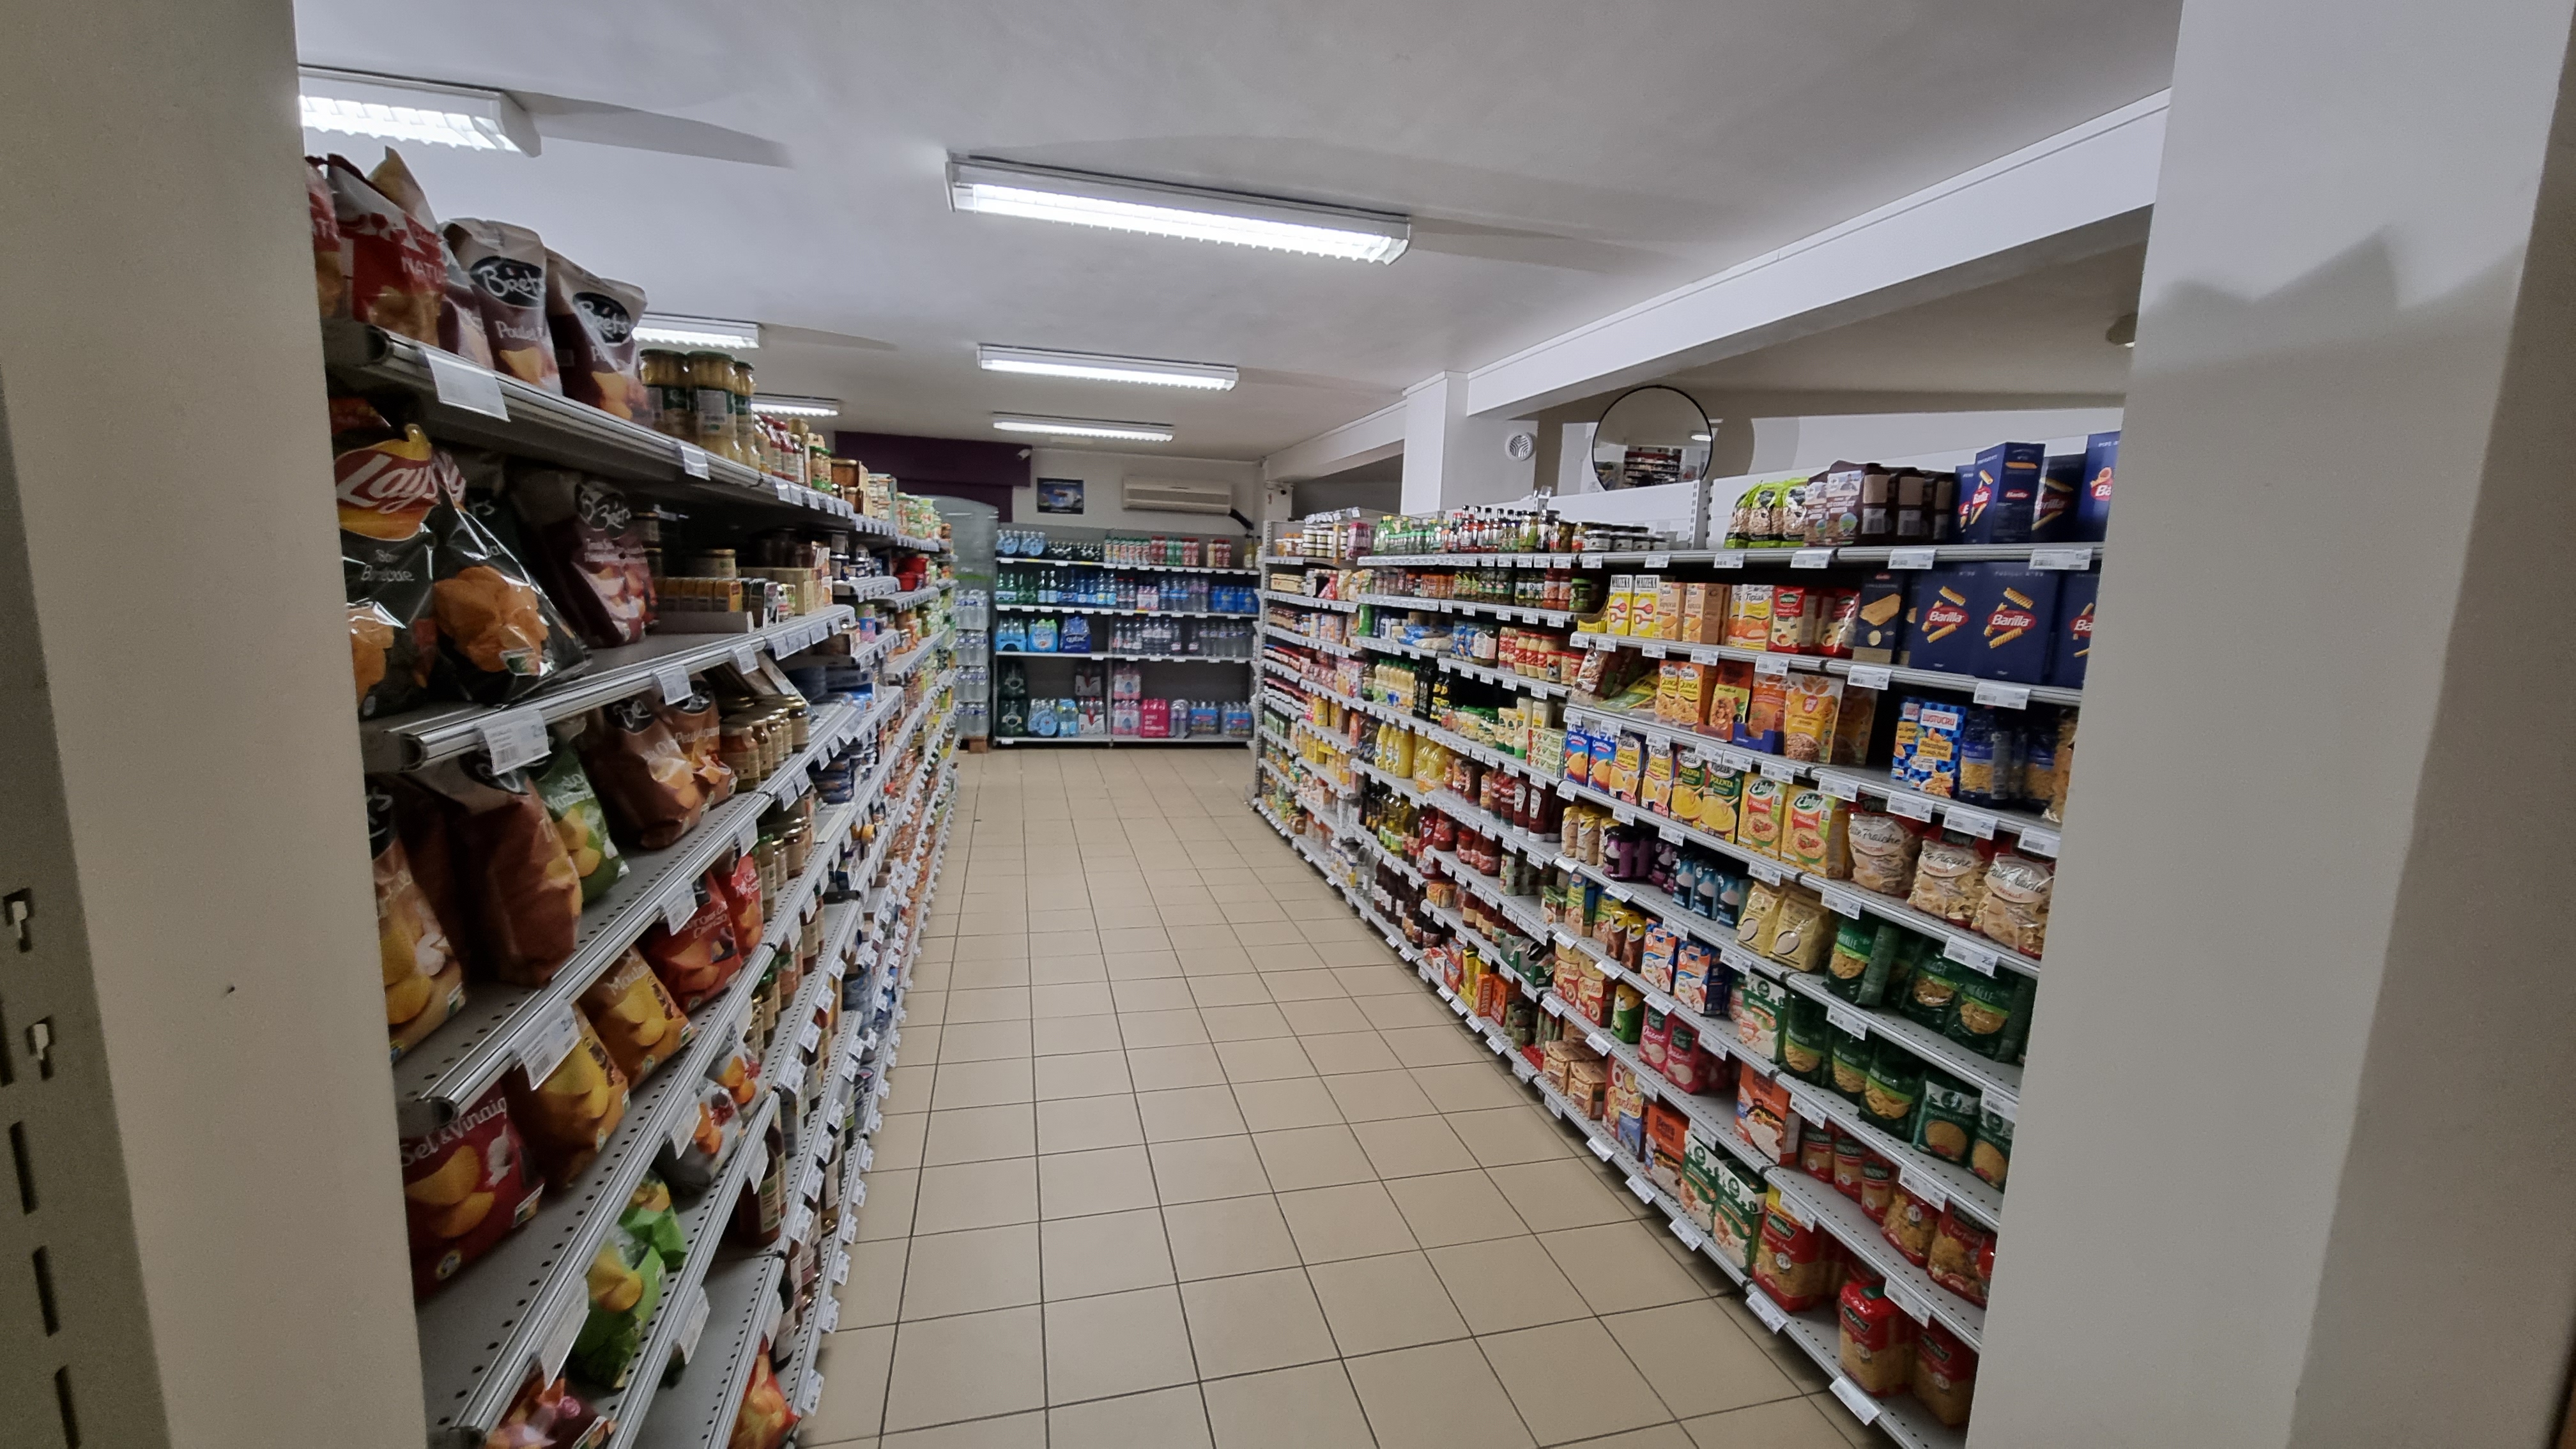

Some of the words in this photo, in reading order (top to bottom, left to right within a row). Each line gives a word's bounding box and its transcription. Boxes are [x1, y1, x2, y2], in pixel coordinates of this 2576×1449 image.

[1745, 593, 1764, 602] Tipiak
[1929, 611, 1965, 624] Barilla
[1991, 614, 2032, 627] Barilla
[401, 1133, 439, 1167] Sel
